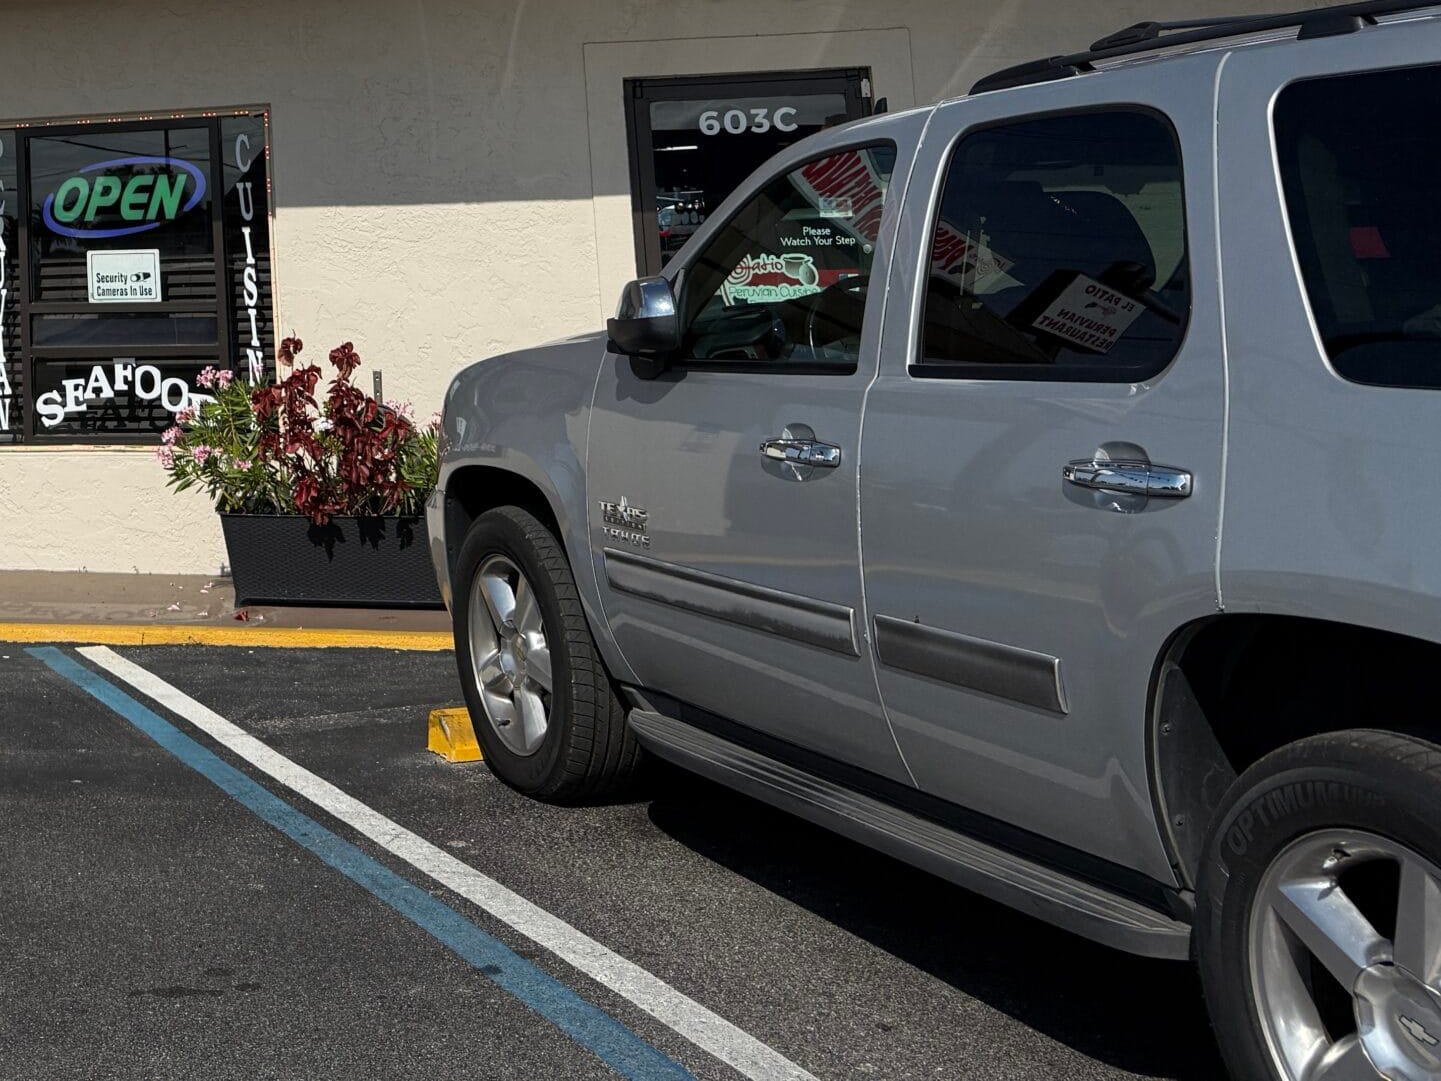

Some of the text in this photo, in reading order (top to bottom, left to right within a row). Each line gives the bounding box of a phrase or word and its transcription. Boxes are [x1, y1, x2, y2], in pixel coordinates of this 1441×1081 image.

[699, 107, 799, 136] 603C
[54, 174, 187, 223] OPEN
[803, 226, 831, 236] Please
[780, 235, 856, 246] Watch Your Step
[96, 273, 128, 285] Security
[235, 134, 264, 420] CUISIN
[97, 285, 152, 296] Cameras In Use
[729, 286, 777, 297] Peruvian
